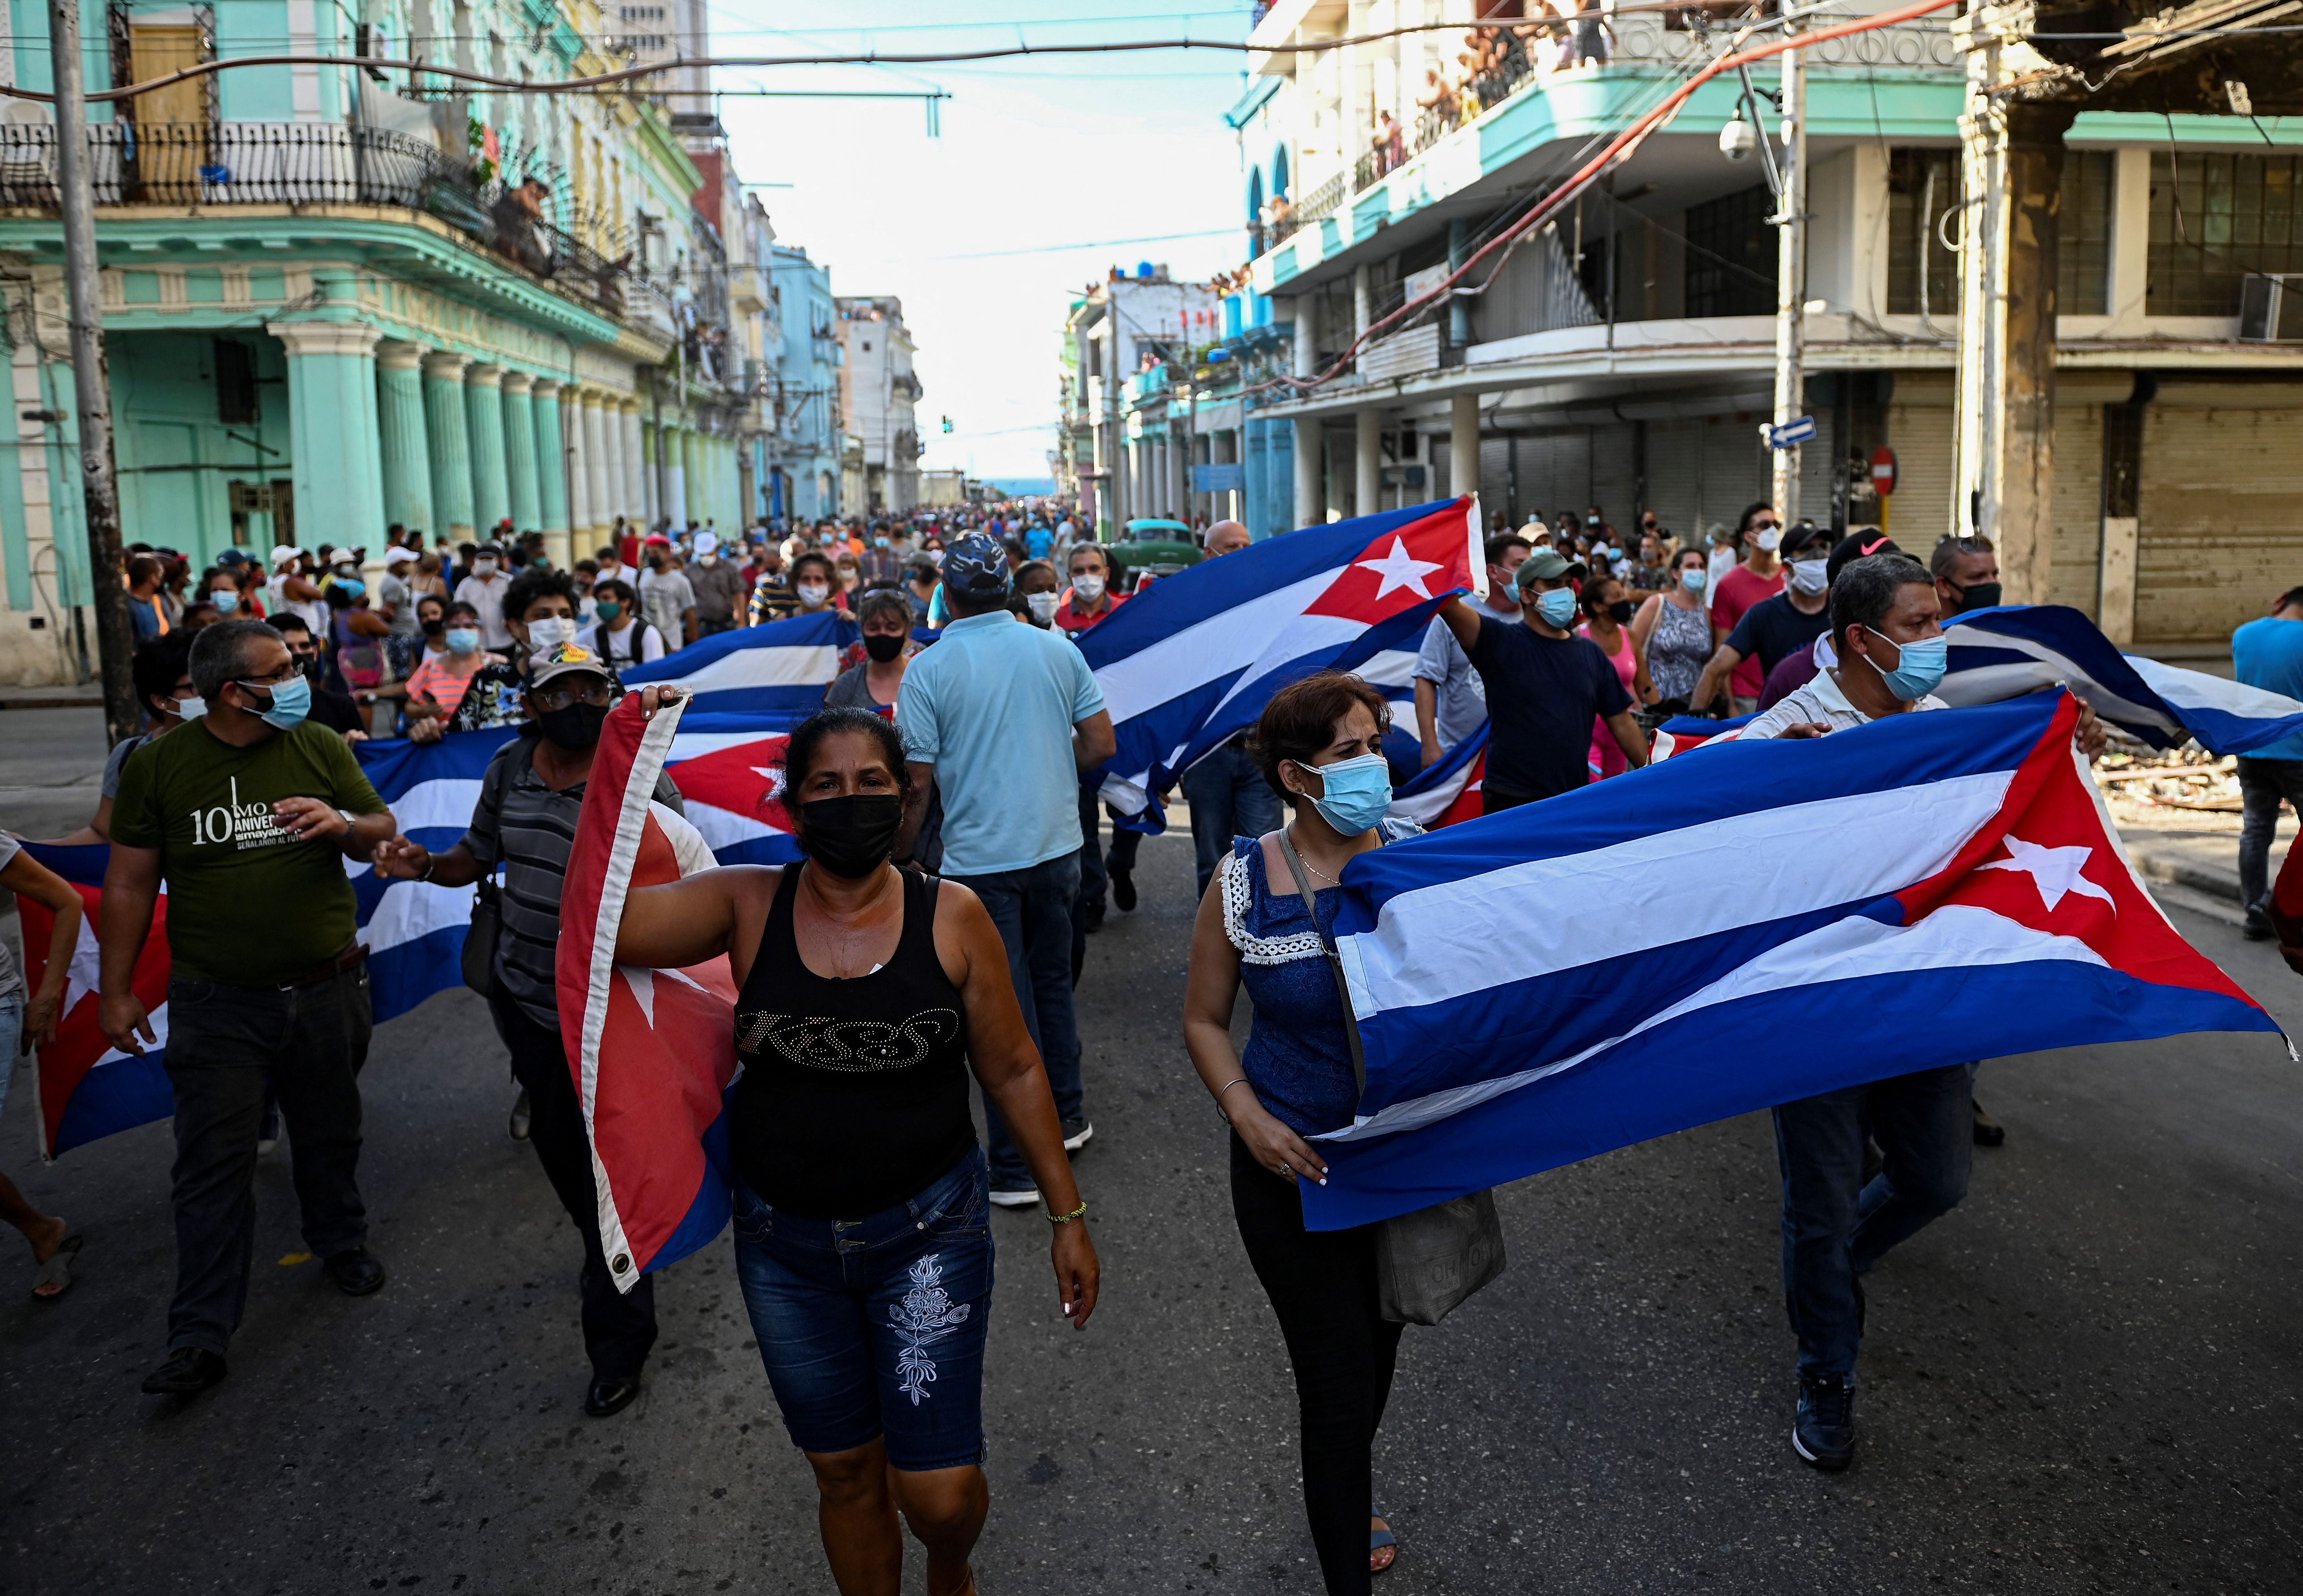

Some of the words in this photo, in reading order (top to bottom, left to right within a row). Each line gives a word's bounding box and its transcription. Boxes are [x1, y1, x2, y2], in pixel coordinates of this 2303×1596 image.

[190, 806, 233, 845] 10
[244, 826, 302, 839] mayab
[237, 838, 276, 850] SEÑALANDO
[277, 837, 285, 845] AL
[287, 835, 300, 843] FUT
